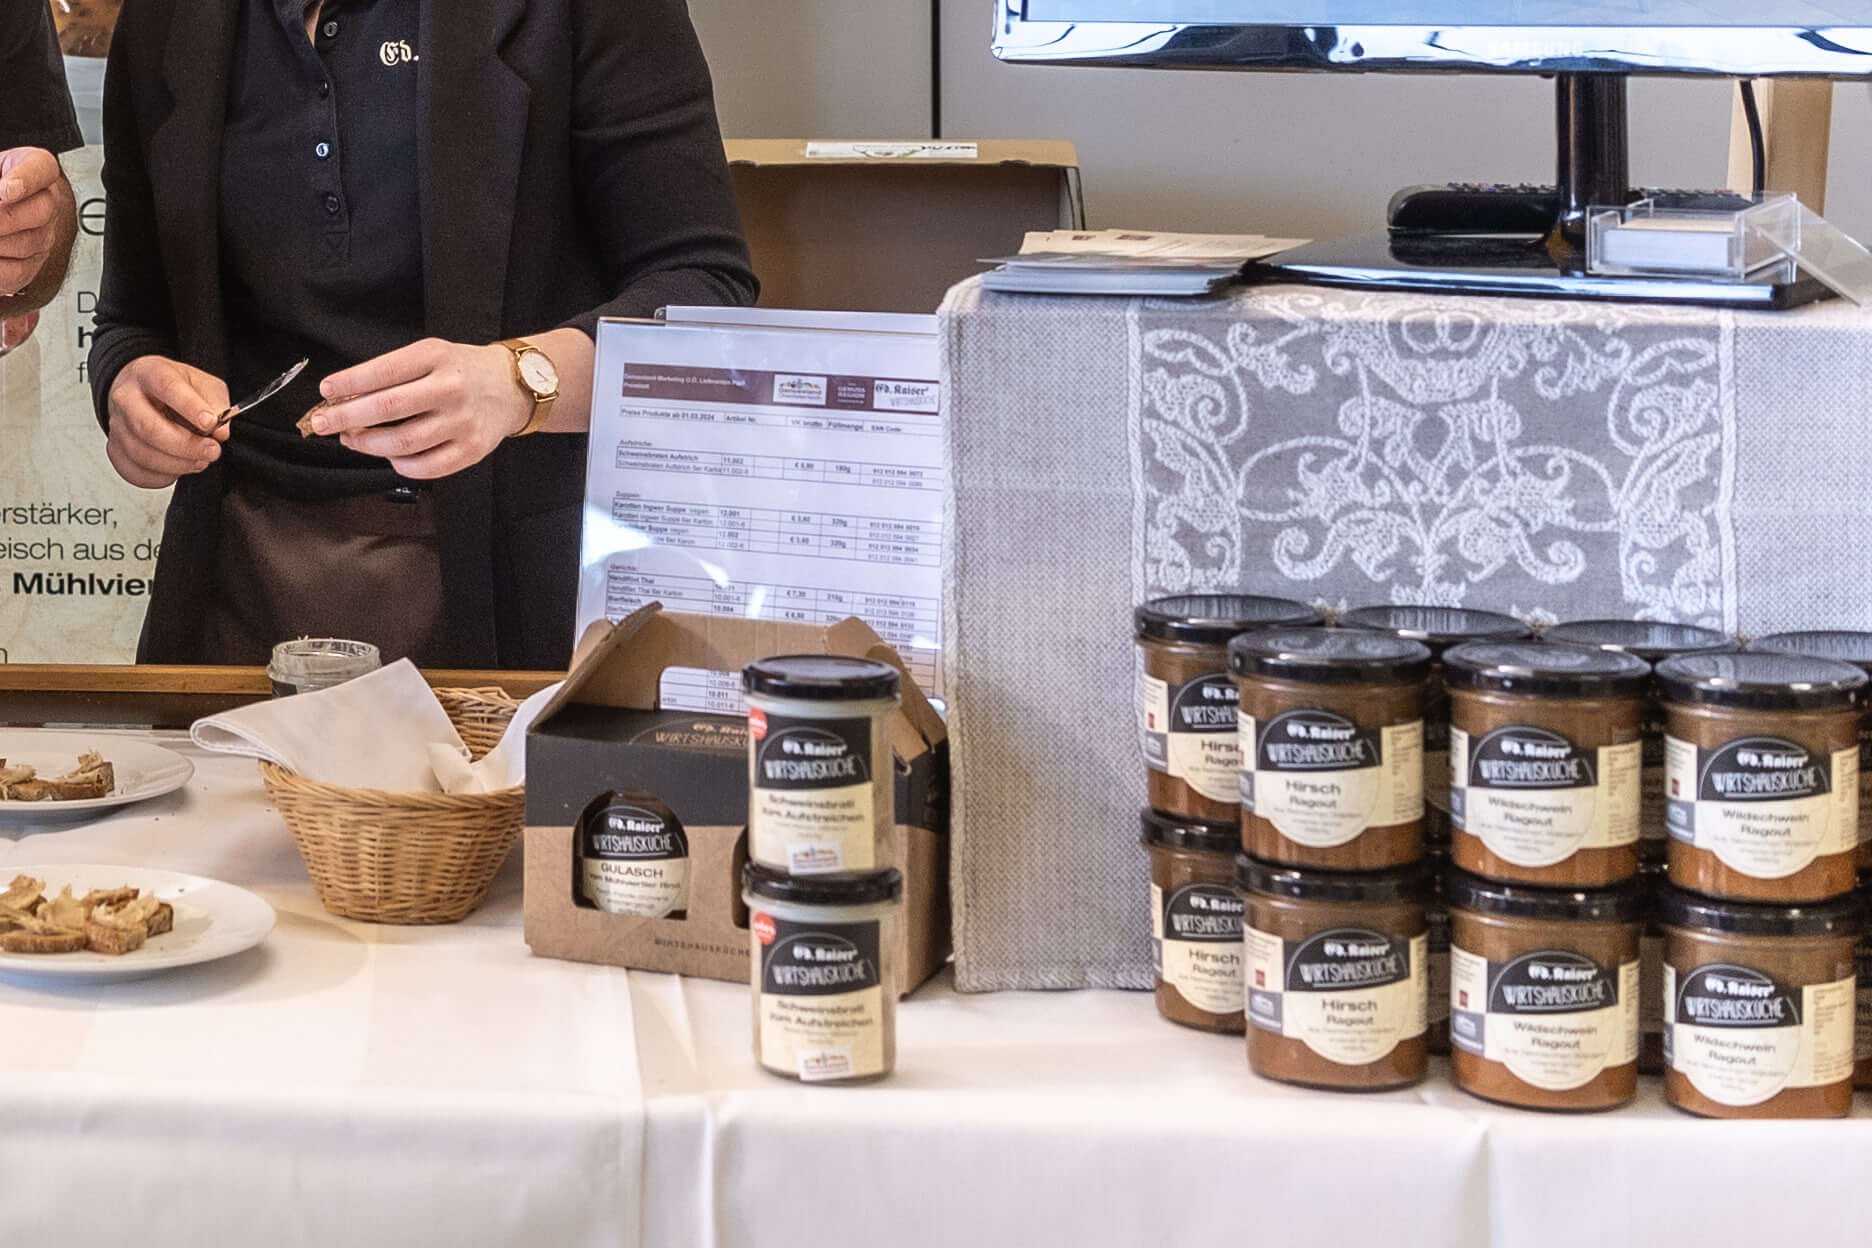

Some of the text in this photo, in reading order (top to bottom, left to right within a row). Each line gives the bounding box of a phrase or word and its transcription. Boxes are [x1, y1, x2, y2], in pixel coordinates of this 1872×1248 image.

[379, 39, 420, 66] Ed.
[74, 543, 125, 561] aus
[1266, 738, 1366, 764] WIRTSHAUSKÜCHE
[1479, 757, 1581, 781] WIRTSHAUSKÜCHE
[1285, 779, 1342, 796] Hirsch
[1712, 766, 1817, 794] WIRTSHAUSKÜCHE
[1289, 795, 1338, 810] Ragout
[1487, 797, 1572, 814] Wildschwein
[1504, 813, 1553, 827] Ragout
[1722, 807, 1810, 825] Wildschwein
[1740, 824, 1791, 838] Ragout
[592, 833, 673, 853] WIRTSHAUSKÜCHE
[600, 862, 664, 878] GULASCH
[1188, 949, 1240, 964] Hirsch
[1192, 965, 1238, 978] Ragout
[1299, 953, 1399, 984] WIRTSHAUSKÜCHE
[1503, 981, 1606, 1007] WIRTSHAUSKÜCHE
[1322, 998, 1378, 1013] Hirsch
[1685, 994, 1785, 1020] WIRTSHAUSKÜCHE
[1326, 1014, 1374, 1028] Ragout
[1513, 1020, 1598, 1036] Wildschwein
[1531, 1037, 1581, 1052] Ragout
[1693, 1032, 1778, 1053] Wildschwein
[1707, 1051, 1759, 1066] Ragout
